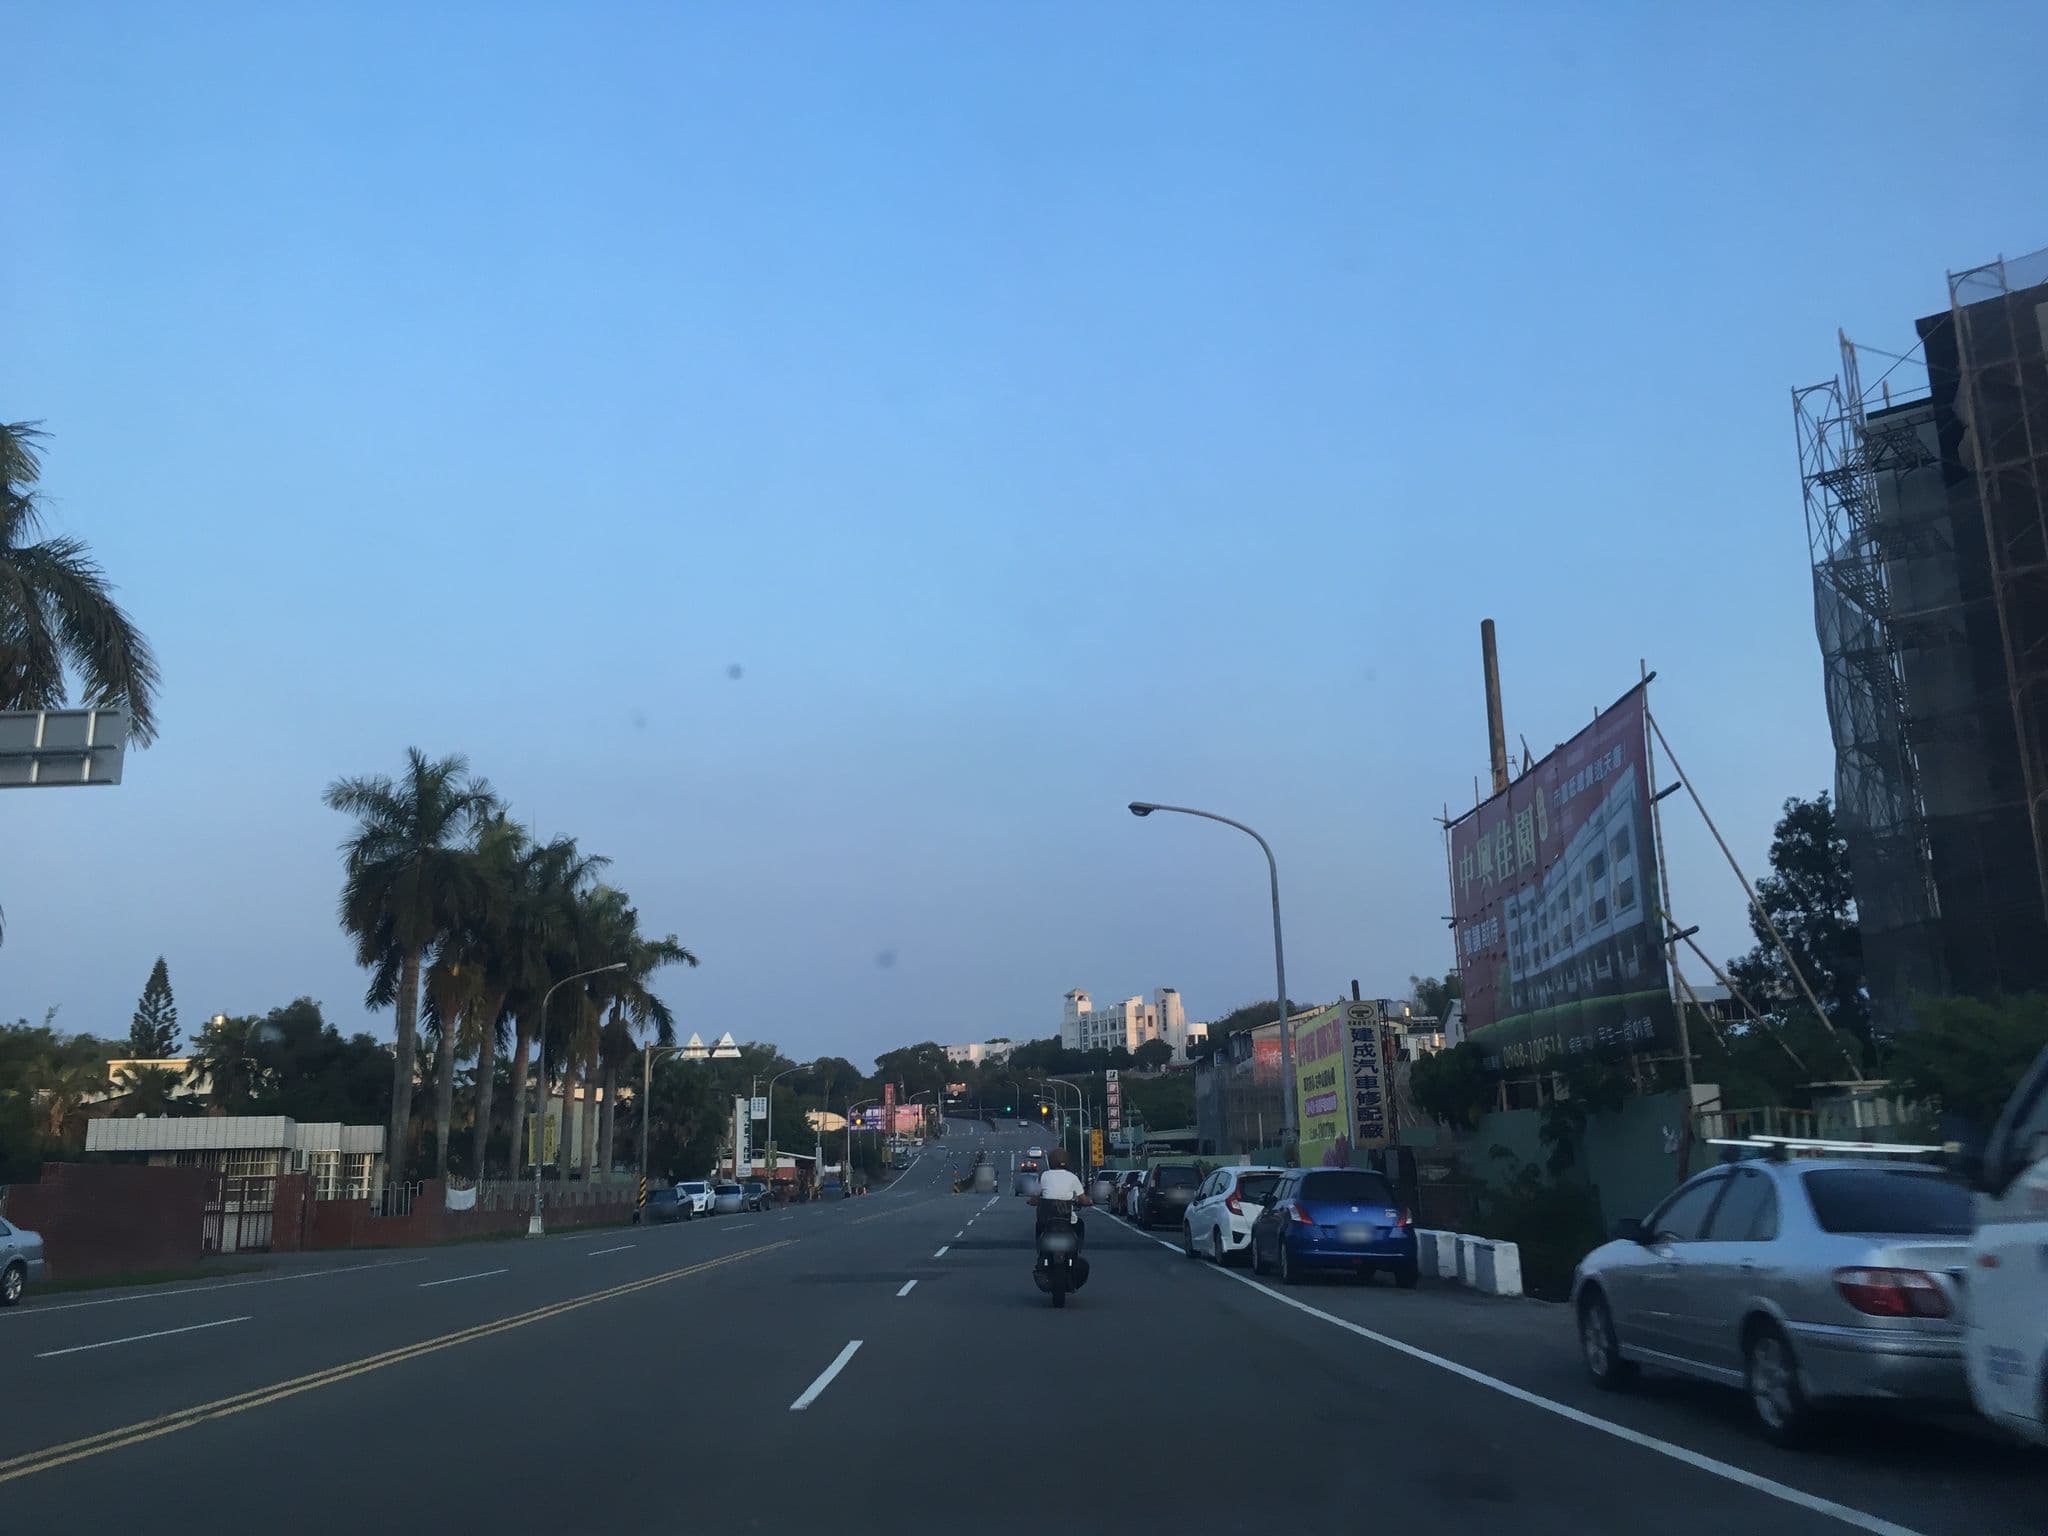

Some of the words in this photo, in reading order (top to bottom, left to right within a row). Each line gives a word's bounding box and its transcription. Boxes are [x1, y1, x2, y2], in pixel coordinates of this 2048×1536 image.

[1350, 1027, 1384, 1138] 建成汽車修配廠
